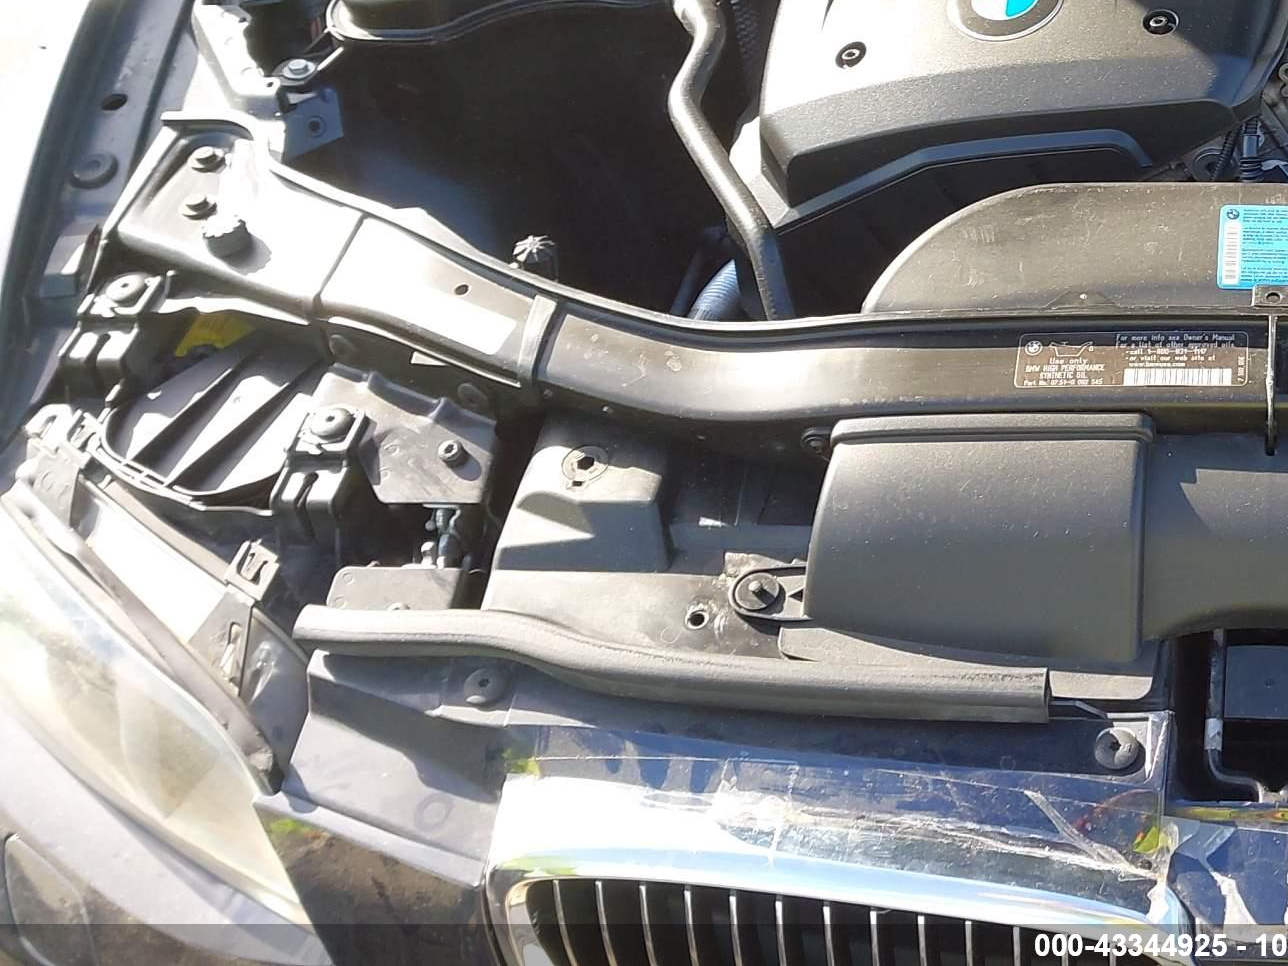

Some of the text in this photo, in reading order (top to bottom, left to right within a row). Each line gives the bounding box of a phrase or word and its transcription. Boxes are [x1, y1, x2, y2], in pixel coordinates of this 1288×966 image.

[1115, 341, 1127, 349] For
[1188, 341, 1218, 349] approved
[1069, 357, 1088, 365] only
[1043, 364, 1058, 372] HIGH
[1061, 363, 1106, 372] PERFORMANCE
[1040, 371, 1088, 379] SYNTHETIC OIL
